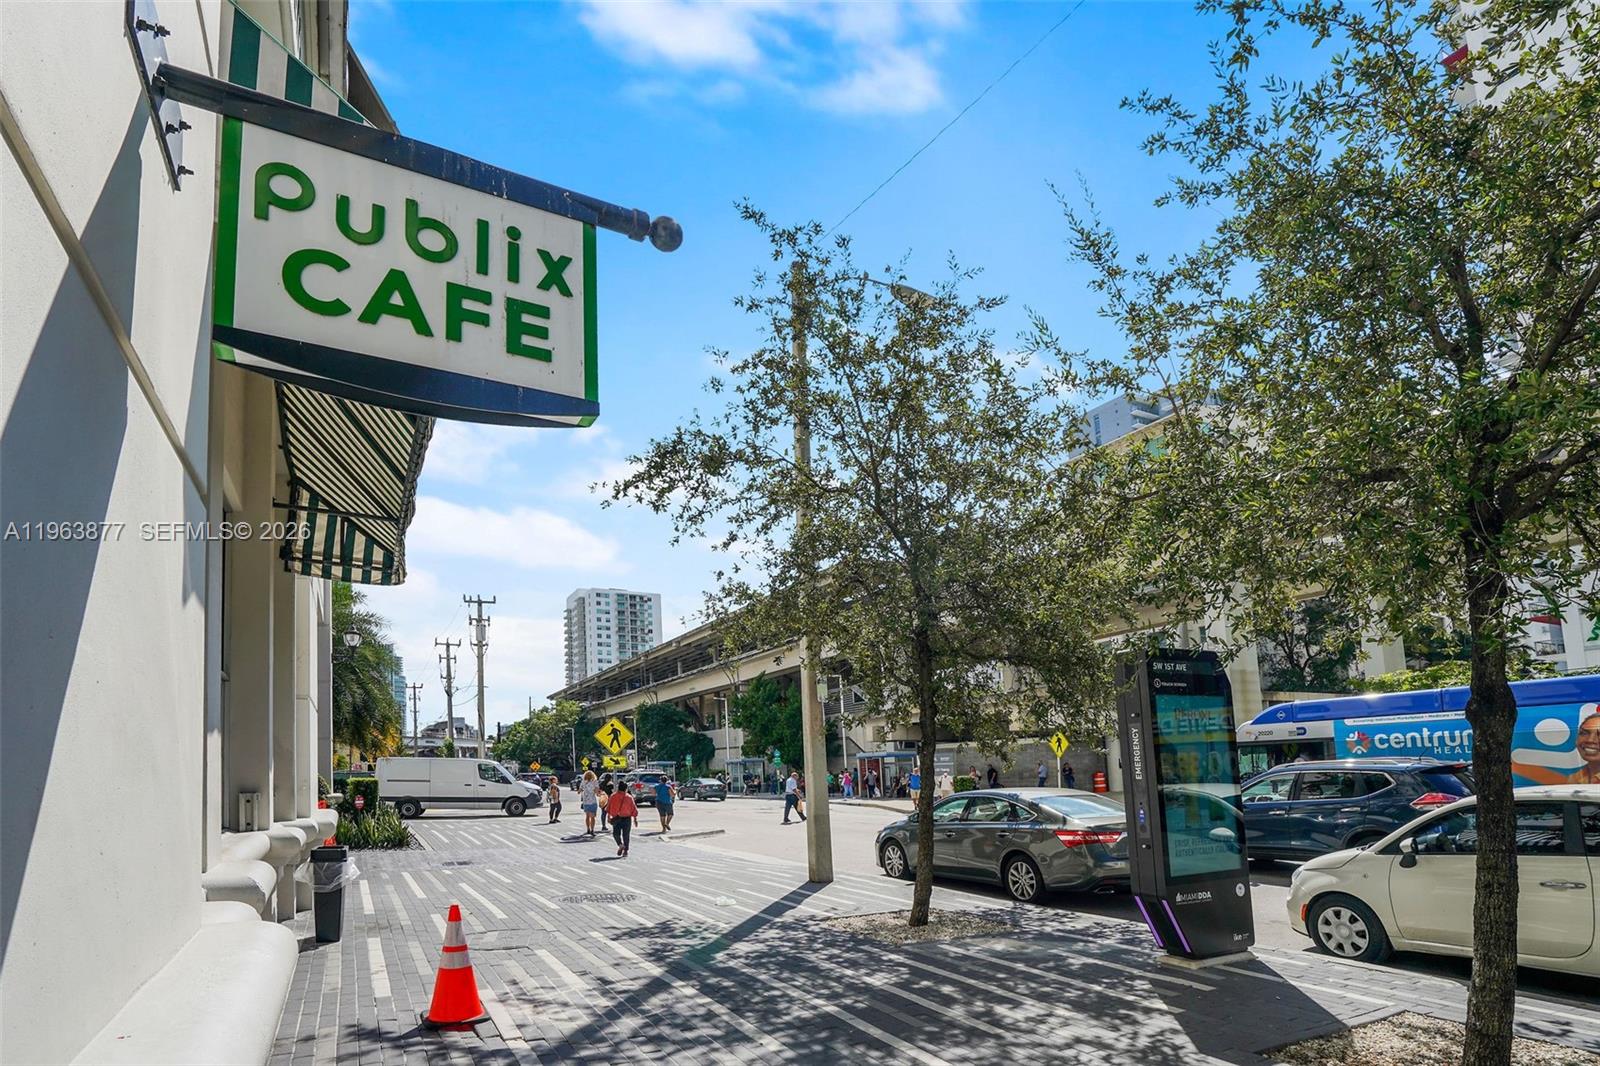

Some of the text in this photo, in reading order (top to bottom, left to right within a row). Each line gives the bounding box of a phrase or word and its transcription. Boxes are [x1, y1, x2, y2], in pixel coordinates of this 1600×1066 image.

[254, 162, 573, 298] Publix
[281, 248, 553, 363] CAFE
[1152, 662, 1187, 671] SW 1ST AVE
[1131, 727, 1143, 780] EMERGENCY
[1434, 746, 1472, 754] HEAL
